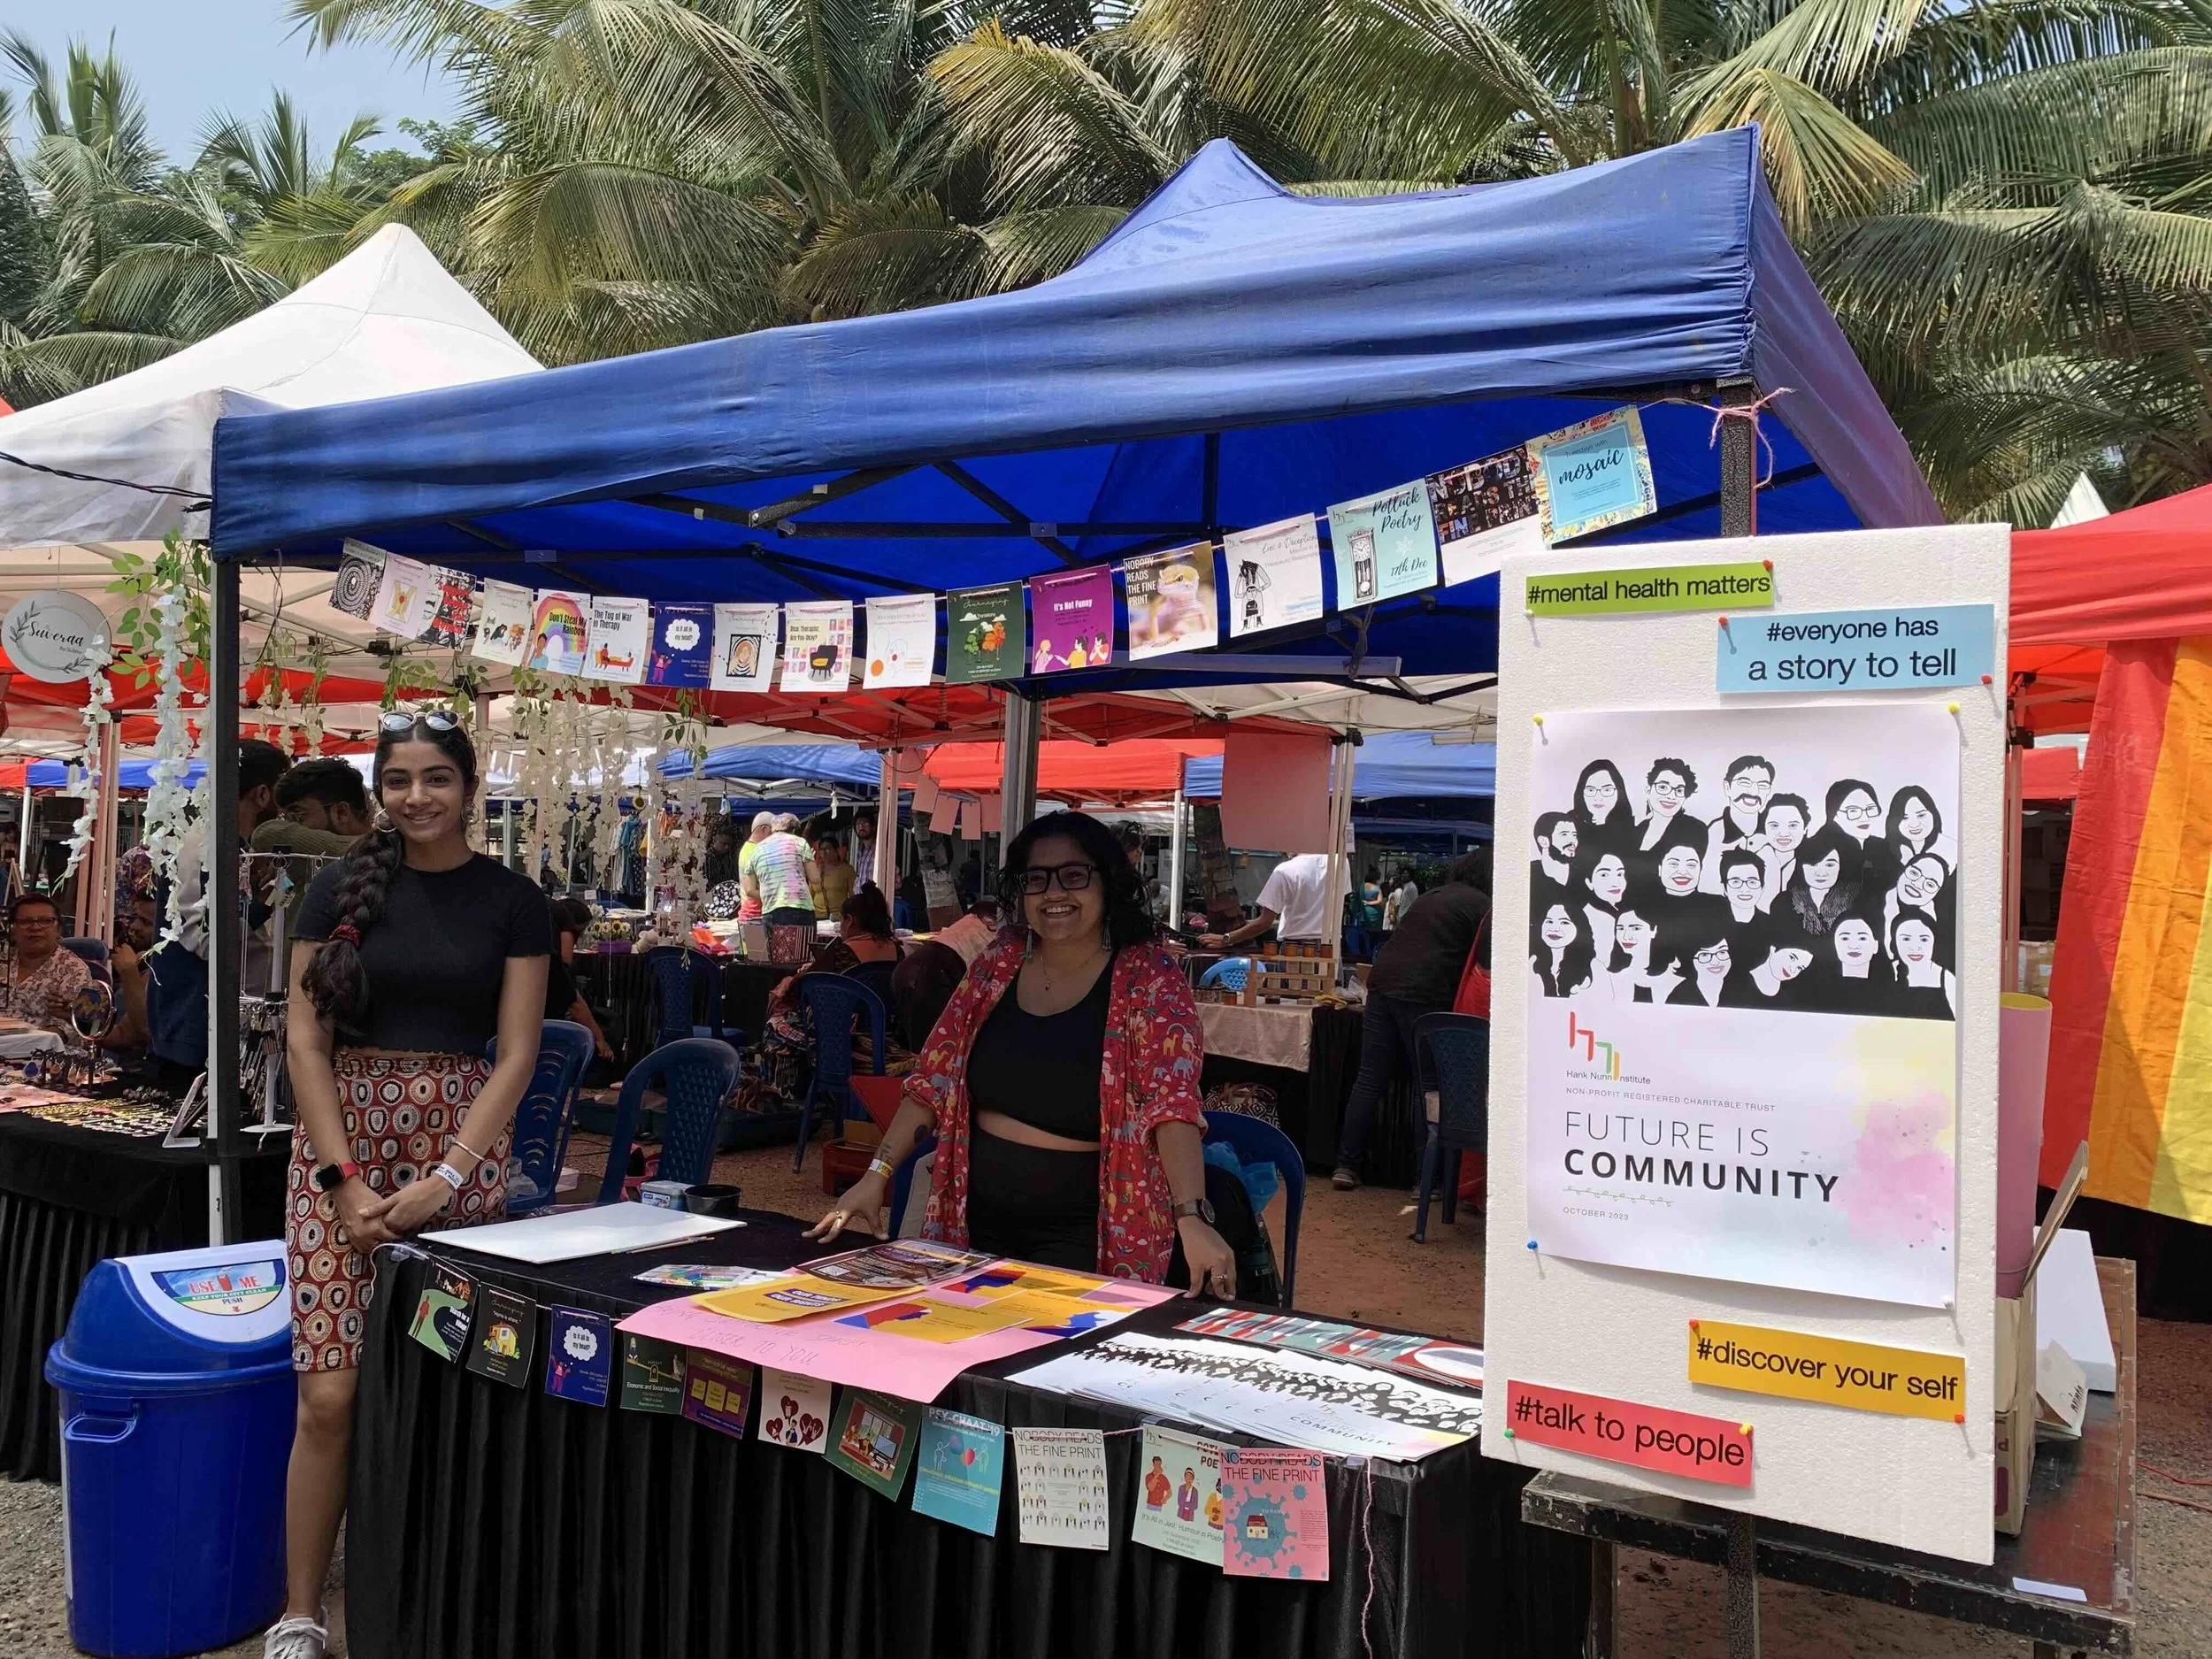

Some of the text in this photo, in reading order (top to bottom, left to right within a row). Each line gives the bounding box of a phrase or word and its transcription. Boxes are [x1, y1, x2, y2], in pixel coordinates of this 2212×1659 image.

[1559, 449, 1624, 486] mosaic
[1372, 486, 1421, 518] Potluck
[1381, 510, 1424, 534] Poetry
[1125, 556, 1155, 572] NOBODY
[1126, 570, 1149, 583] READS
[1127, 580, 1156, 595] THE FINE
[1528, 575, 1771, 604] #mental health matters
[1064, 600, 1075, 611] Not
[1074, 598, 1093, 611] Funny
[564, 613, 579, 626] Steal
[594, 609, 633, 622] The Tug of War
[599, 619, 621, 631] Therapy
[1766, 616, 1939, 644] #everyone has
[1748, 647, 1957, 686] a story to tell
[1566, 1070, 1588, 1079] Hank
[1590, 1071, 1613, 1081] Nunn
[1566, 1087, 1777, 1113] NON-PROFIT REGISTERED CHARITABLE TRUST
[1566, 1110, 1769, 1157] FUTURE IS
[1563, 1148, 1840, 1202] COMMUNITY
[1562, 1206, 1630, 1221] OCTOBER 2023
[188, 1275, 261, 1294] USE ME
[222, 1296, 243, 1305] PUSH
[779, 1343, 822, 1368] YOU
[1696, 1337, 1958, 1402] #discover your self
[1014, 1430, 1103, 1445] NOBODY READS
[1289, 1416, 1396, 1446] COMMUNITY
[1514, 1394, 1745, 1468] #talk to people
[1018, 1444, 1102, 1459] THE FINE PRINT
[1220, 1451, 1322, 1467] NOBODY READS
[1225, 1467, 1321, 1483] THE FINE PRINT
